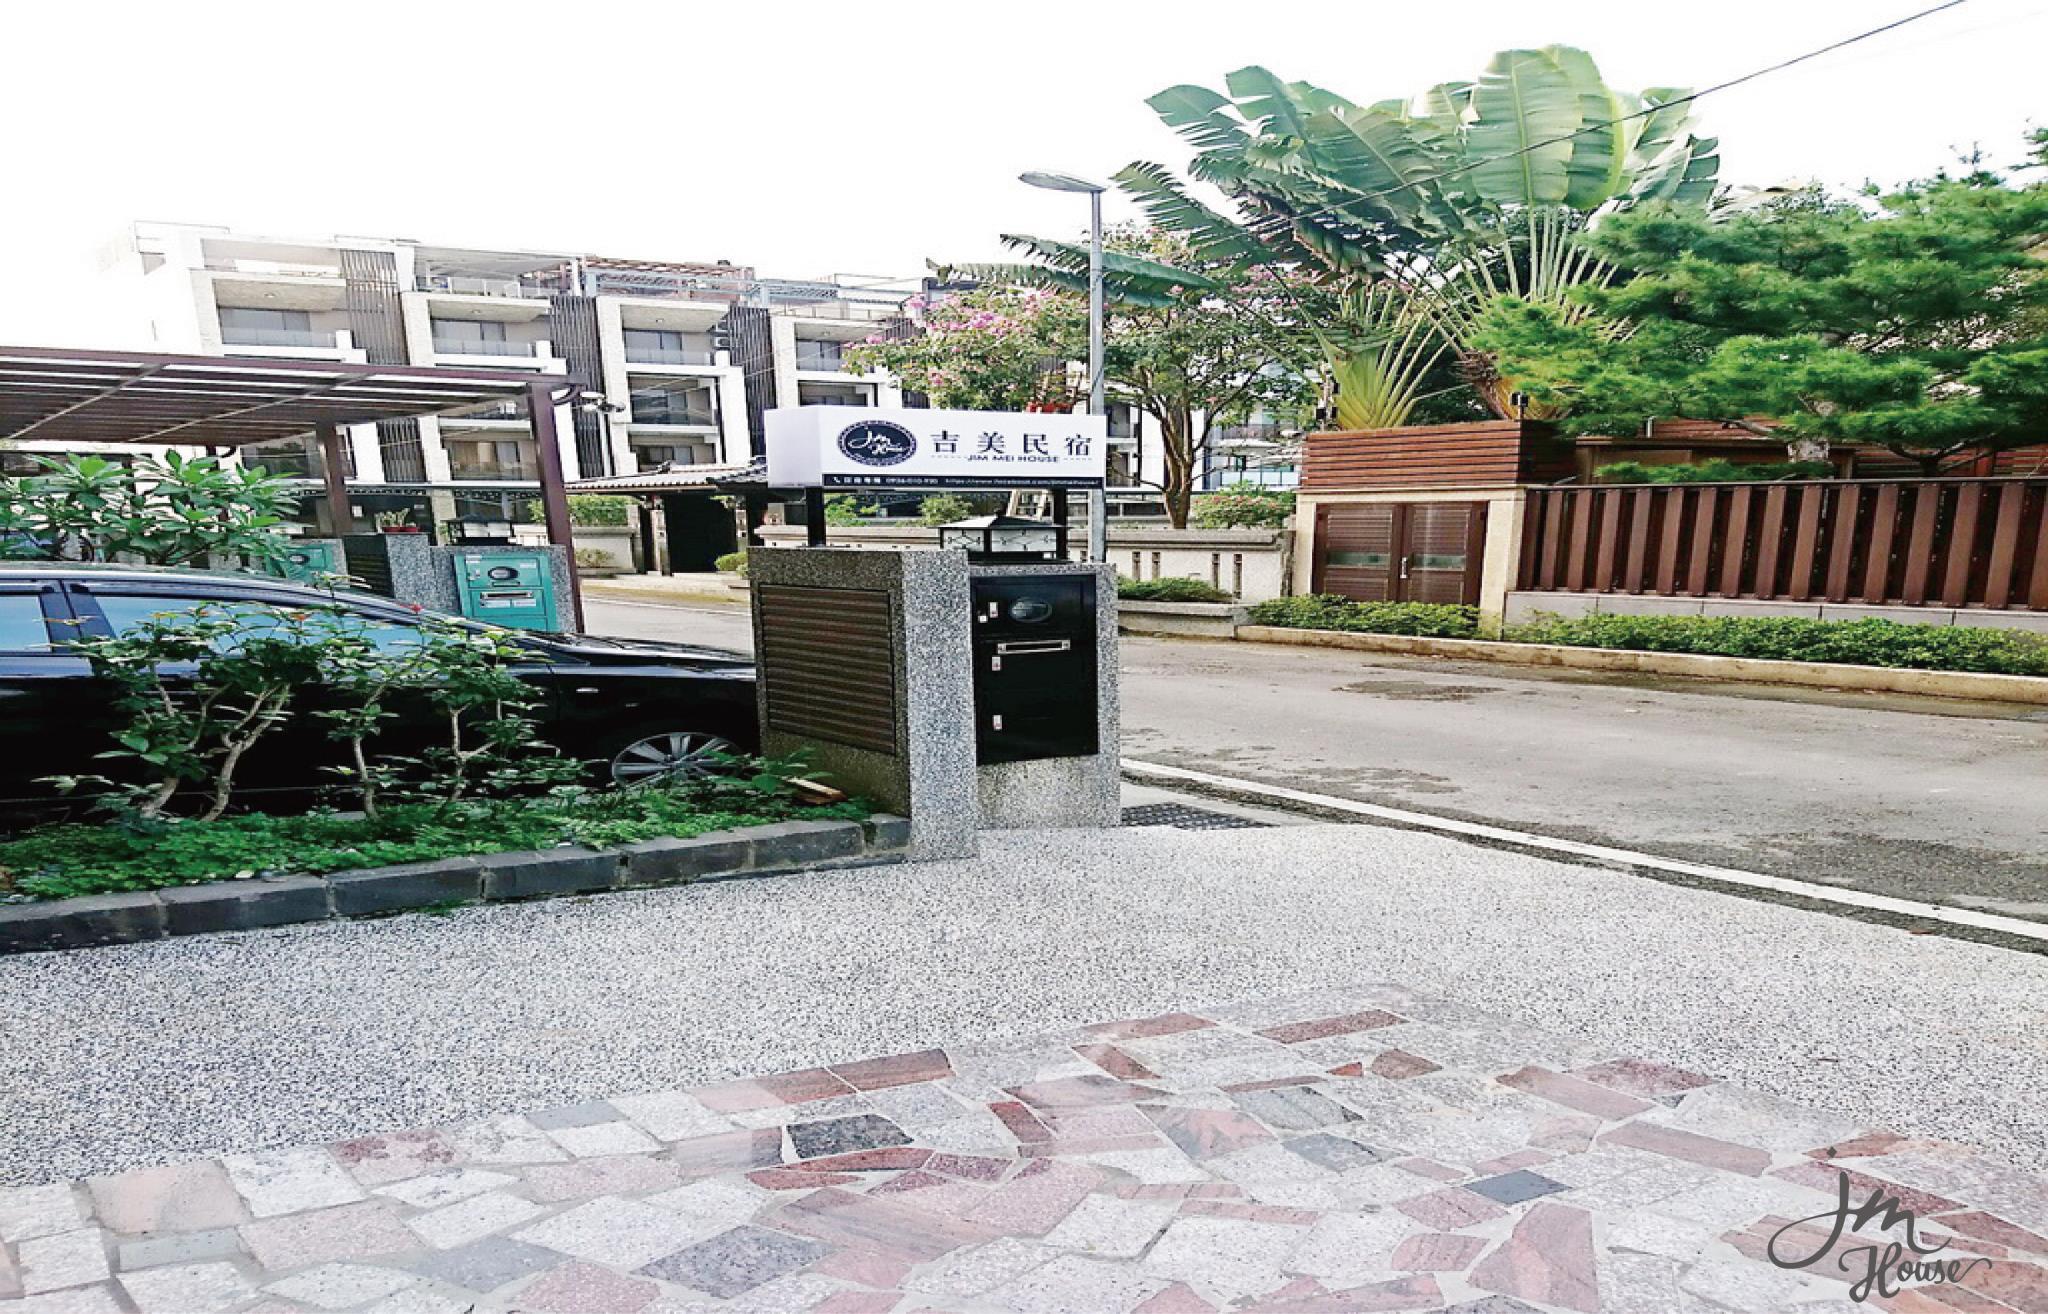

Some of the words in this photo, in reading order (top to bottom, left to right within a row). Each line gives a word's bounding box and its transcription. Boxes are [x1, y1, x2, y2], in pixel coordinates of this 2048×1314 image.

[930, 429, 1093, 456] 吉美民宿
[967, 454, 989, 462] JIM
[991, 454, 1014, 463] MEI
[1017, 455, 1059, 464] HOUSE
